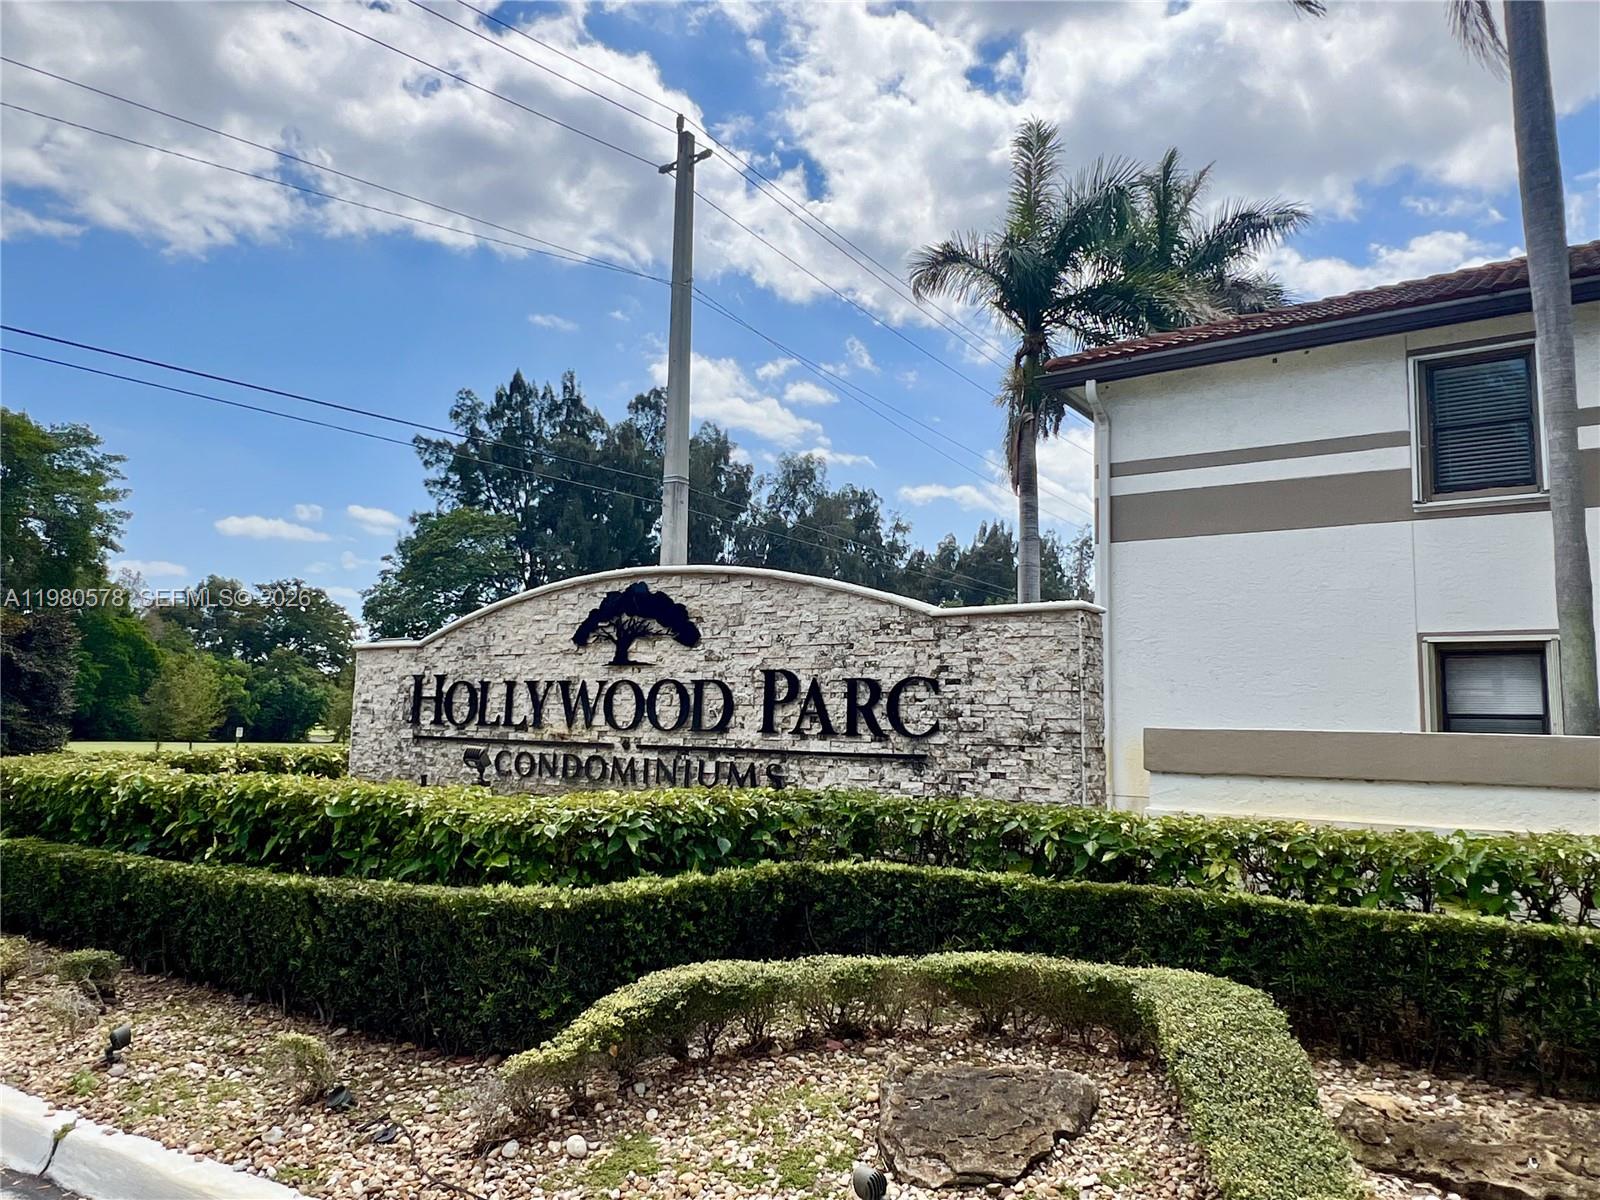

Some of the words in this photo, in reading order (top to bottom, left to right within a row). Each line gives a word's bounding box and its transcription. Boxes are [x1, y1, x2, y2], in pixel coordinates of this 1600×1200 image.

[407, 673, 735, 733] HOLLYWOOD
[757, 669, 941, 738] PARC
[494, 750, 786, 790] CONDOMINIUMS
